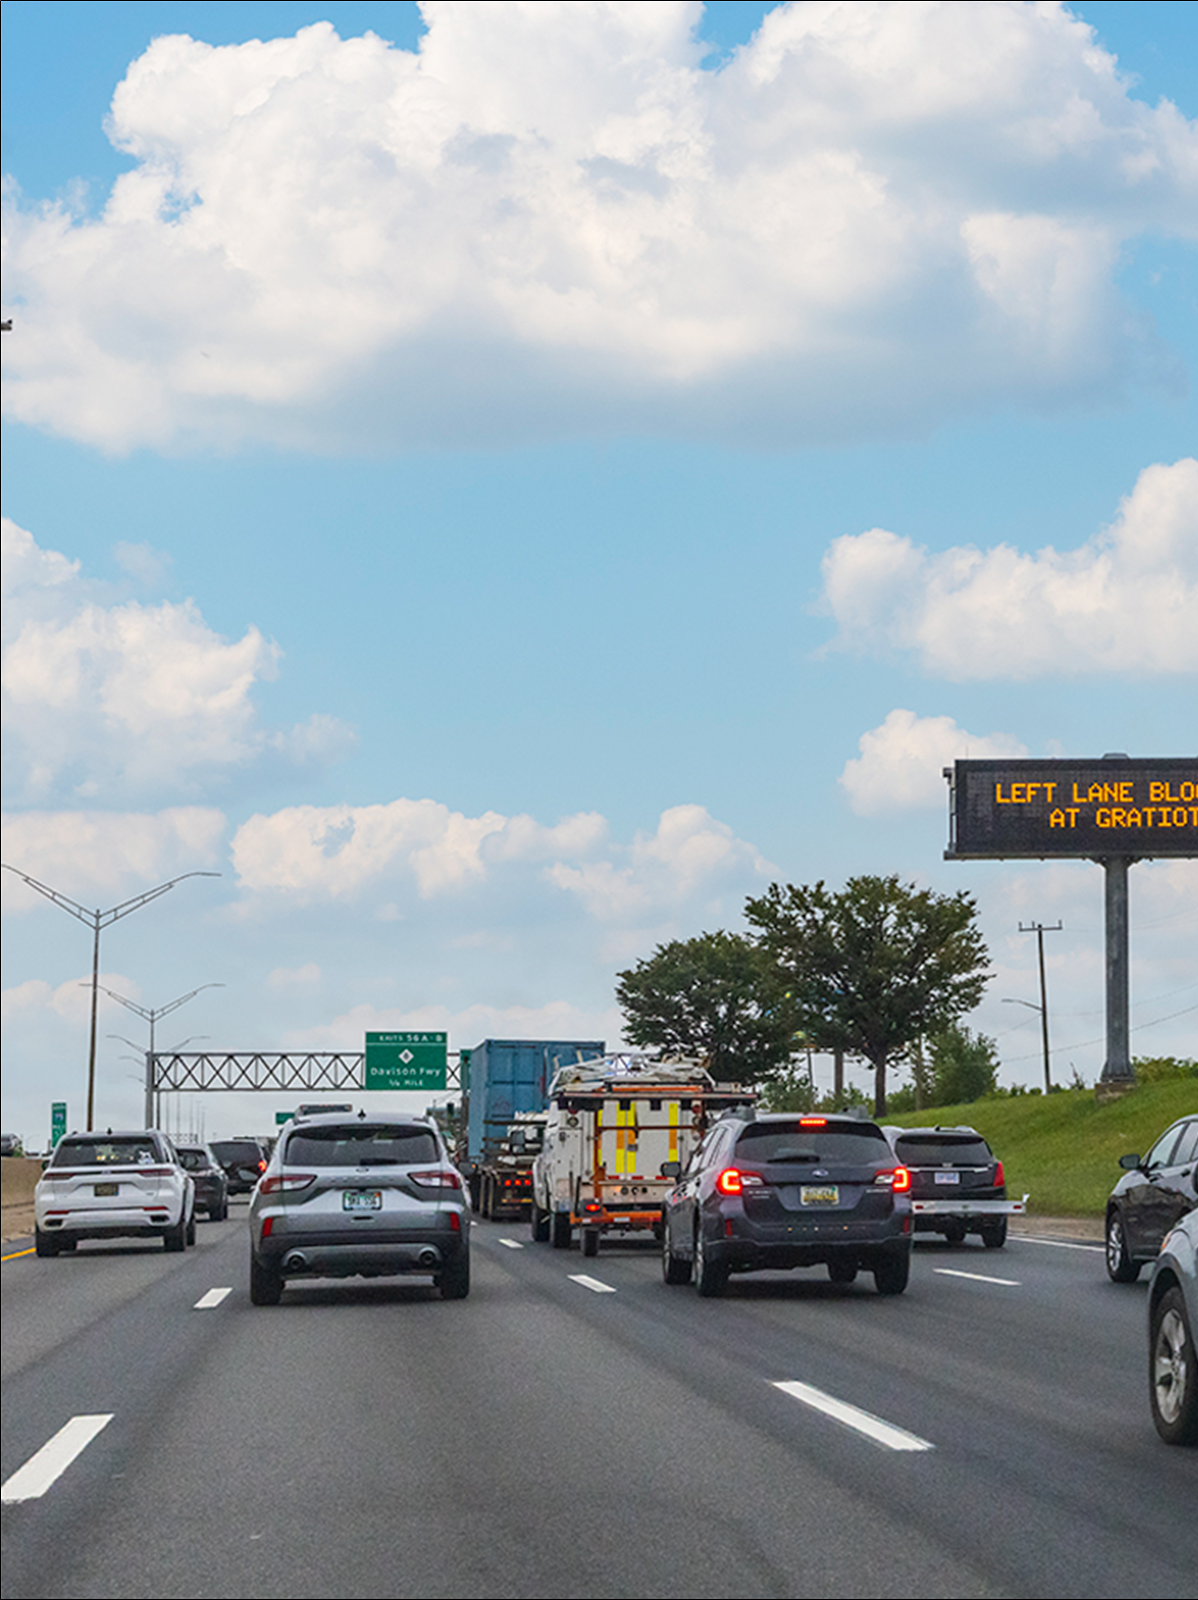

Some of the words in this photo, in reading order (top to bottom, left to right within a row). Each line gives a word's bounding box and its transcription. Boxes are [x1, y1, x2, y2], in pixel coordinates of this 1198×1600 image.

[996, 783, 1057, 803] LEFT
[1073, 782, 1133, 803] LANE
[1050, 808, 1080, 828] AT
[370, 1067, 417, 1076] Davison
[420, 1067, 441, 1077] Fwy
